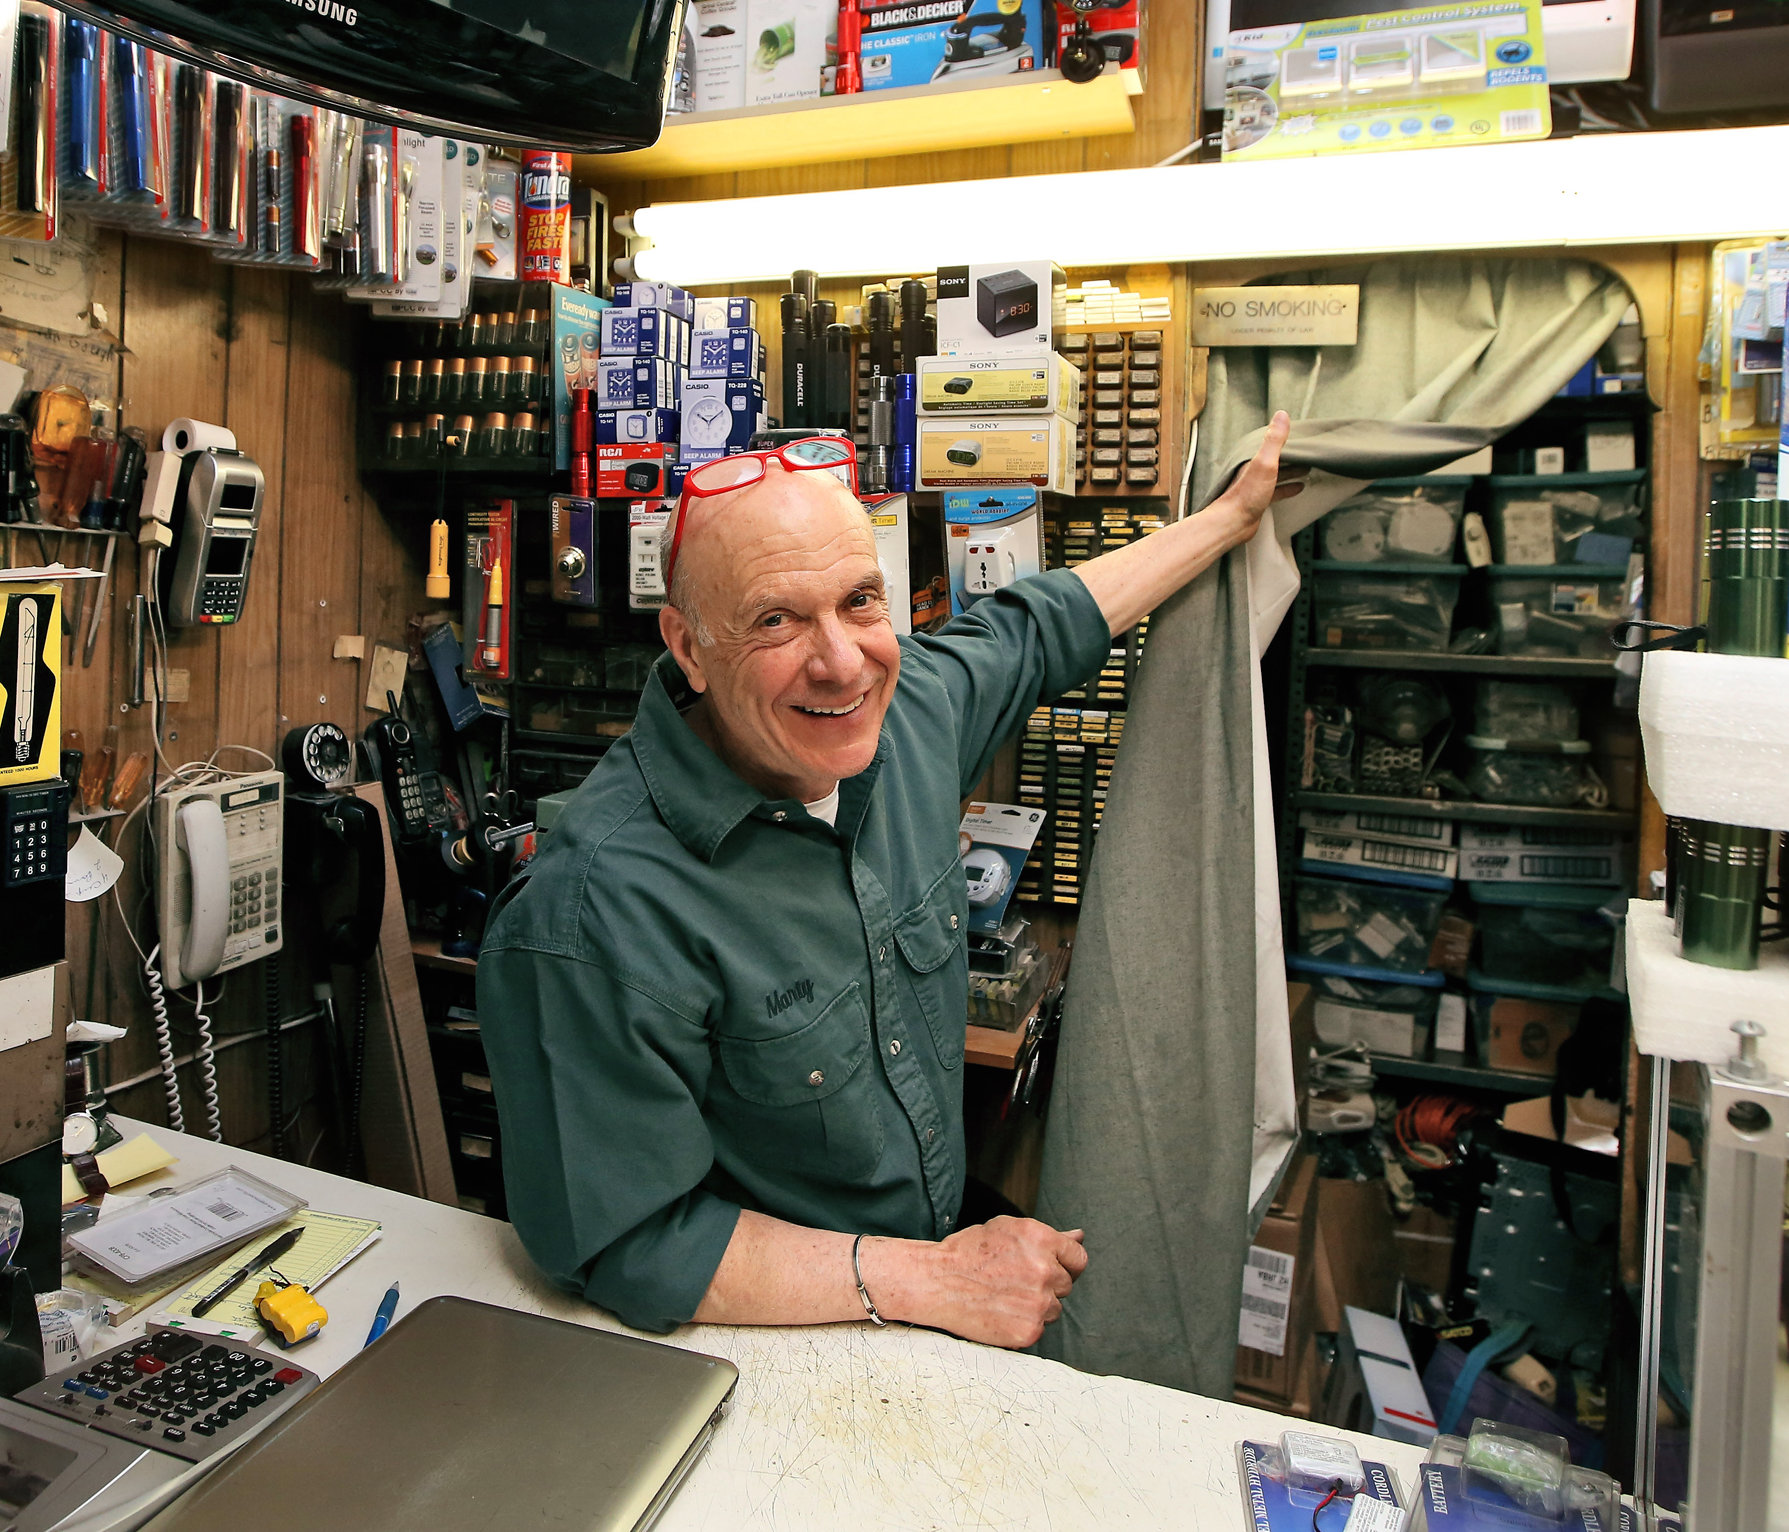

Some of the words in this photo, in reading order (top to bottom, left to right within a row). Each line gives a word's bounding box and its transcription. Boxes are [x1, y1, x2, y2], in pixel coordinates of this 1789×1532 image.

[1366, 16, 1398, 30] Pest
[1402, 8, 1460, 23] Control
[1463, 2, 1520, 16] System
[915, 32, 936, 42] IRON
[524, 172, 570, 199] Tundra
[529, 212, 564, 227] STOP
[527, 225, 563, 240] FIRES
[939, 278, 965, 286] SONY
[1206, 301, 1236, 318] NO
[1245, 300, 1343, 317] SMOKING
[599, 448, 623, 457] RCA
[40, 820, 47, 830] 0
[15, 839, 20, 849] 1
[28, 837, 34, 847] 2
[40, 835, 47, 844] 3
[14, 854, 20, 863] 4
[28, 851, 34, 861] 5
[40, 849, 46, 858] 6
[14, 869, 20, 878] 7
[27, 866, 34, 875] 8
[40, 864, 46, 872] 9
[1243, 1446, 1263, 1488] HYDRIDE
[1426, 1469, 1448, 1515] BATTERY
[1250, 1488, 1267, 1519] METAL
